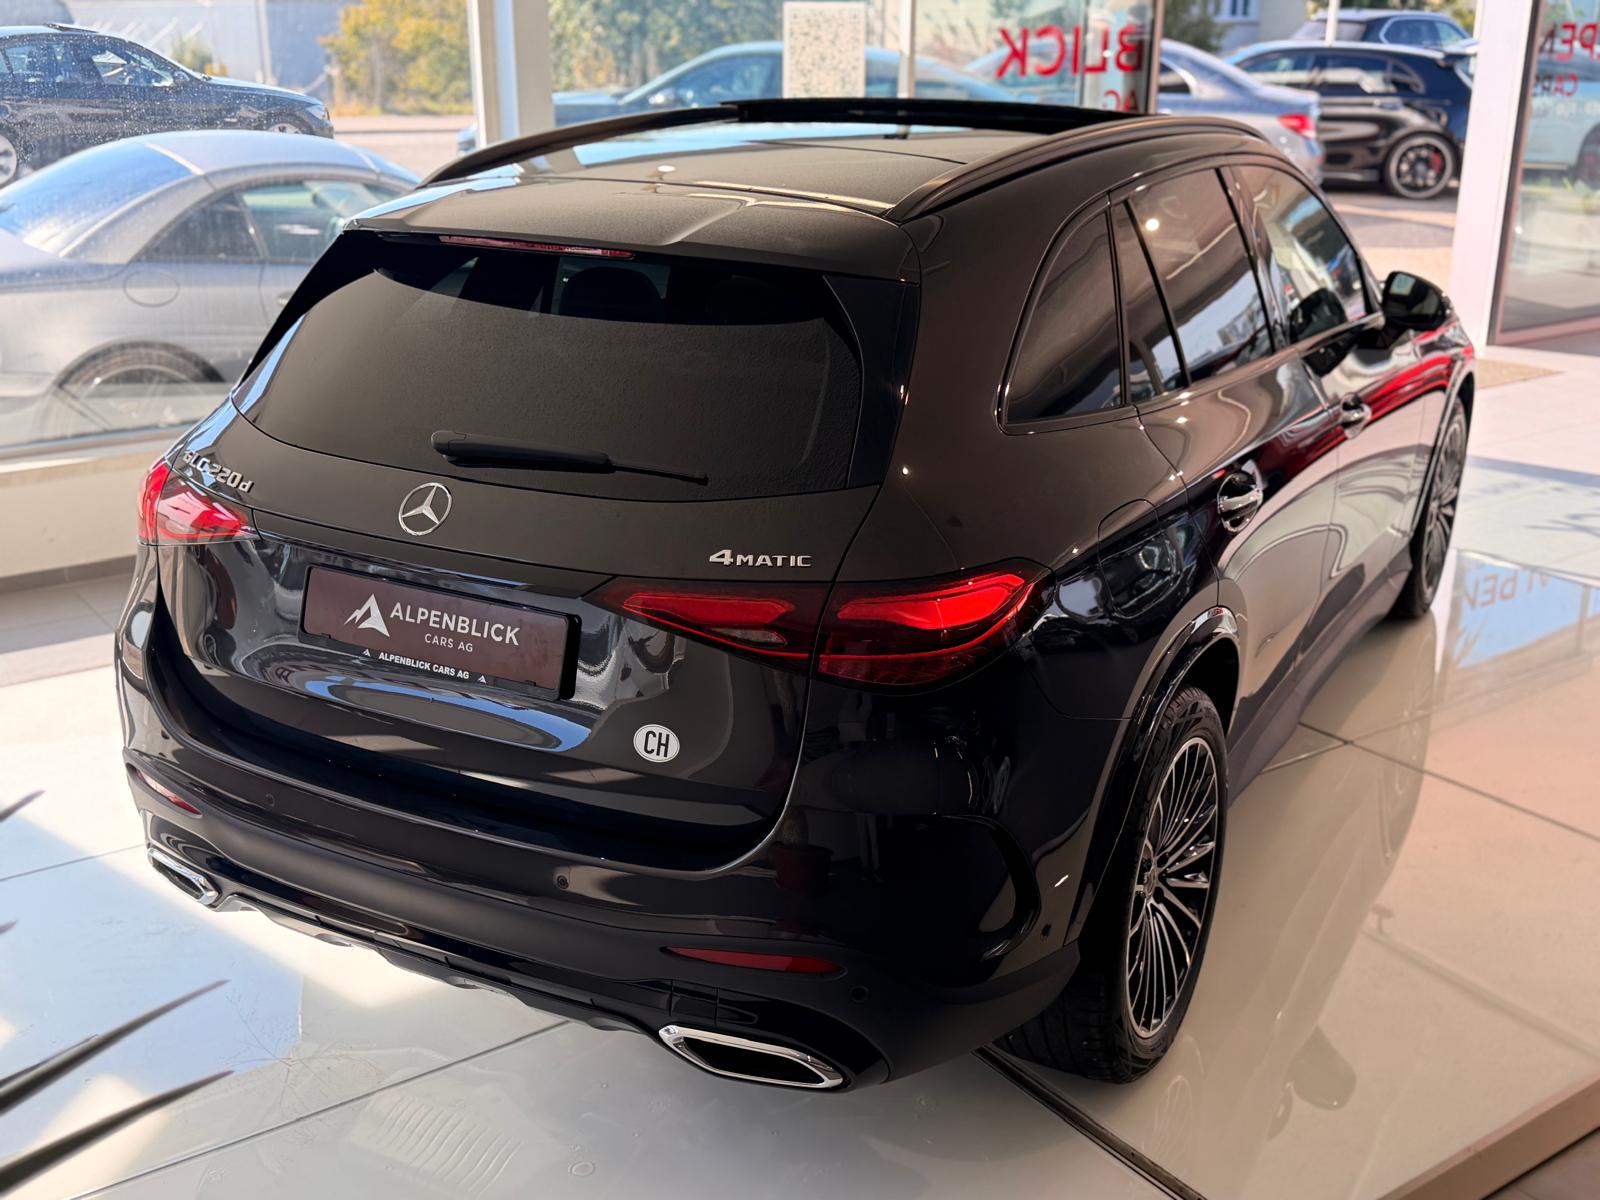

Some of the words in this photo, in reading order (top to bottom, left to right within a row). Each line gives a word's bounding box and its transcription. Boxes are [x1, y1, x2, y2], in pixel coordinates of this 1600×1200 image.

[708, 549, 813, 568] 4MATIC
[390, 602, 521, 647] ALPENBLICK
[424, 633, 454, 649] CARS
[457, 641, 474, 653] AG
[378, 651, 432, 671] ALPENBLICK
[432, 663, 456, 677] CARS
[456, 669, 470, 680] AG
[643, 730, 670, 758] CH
